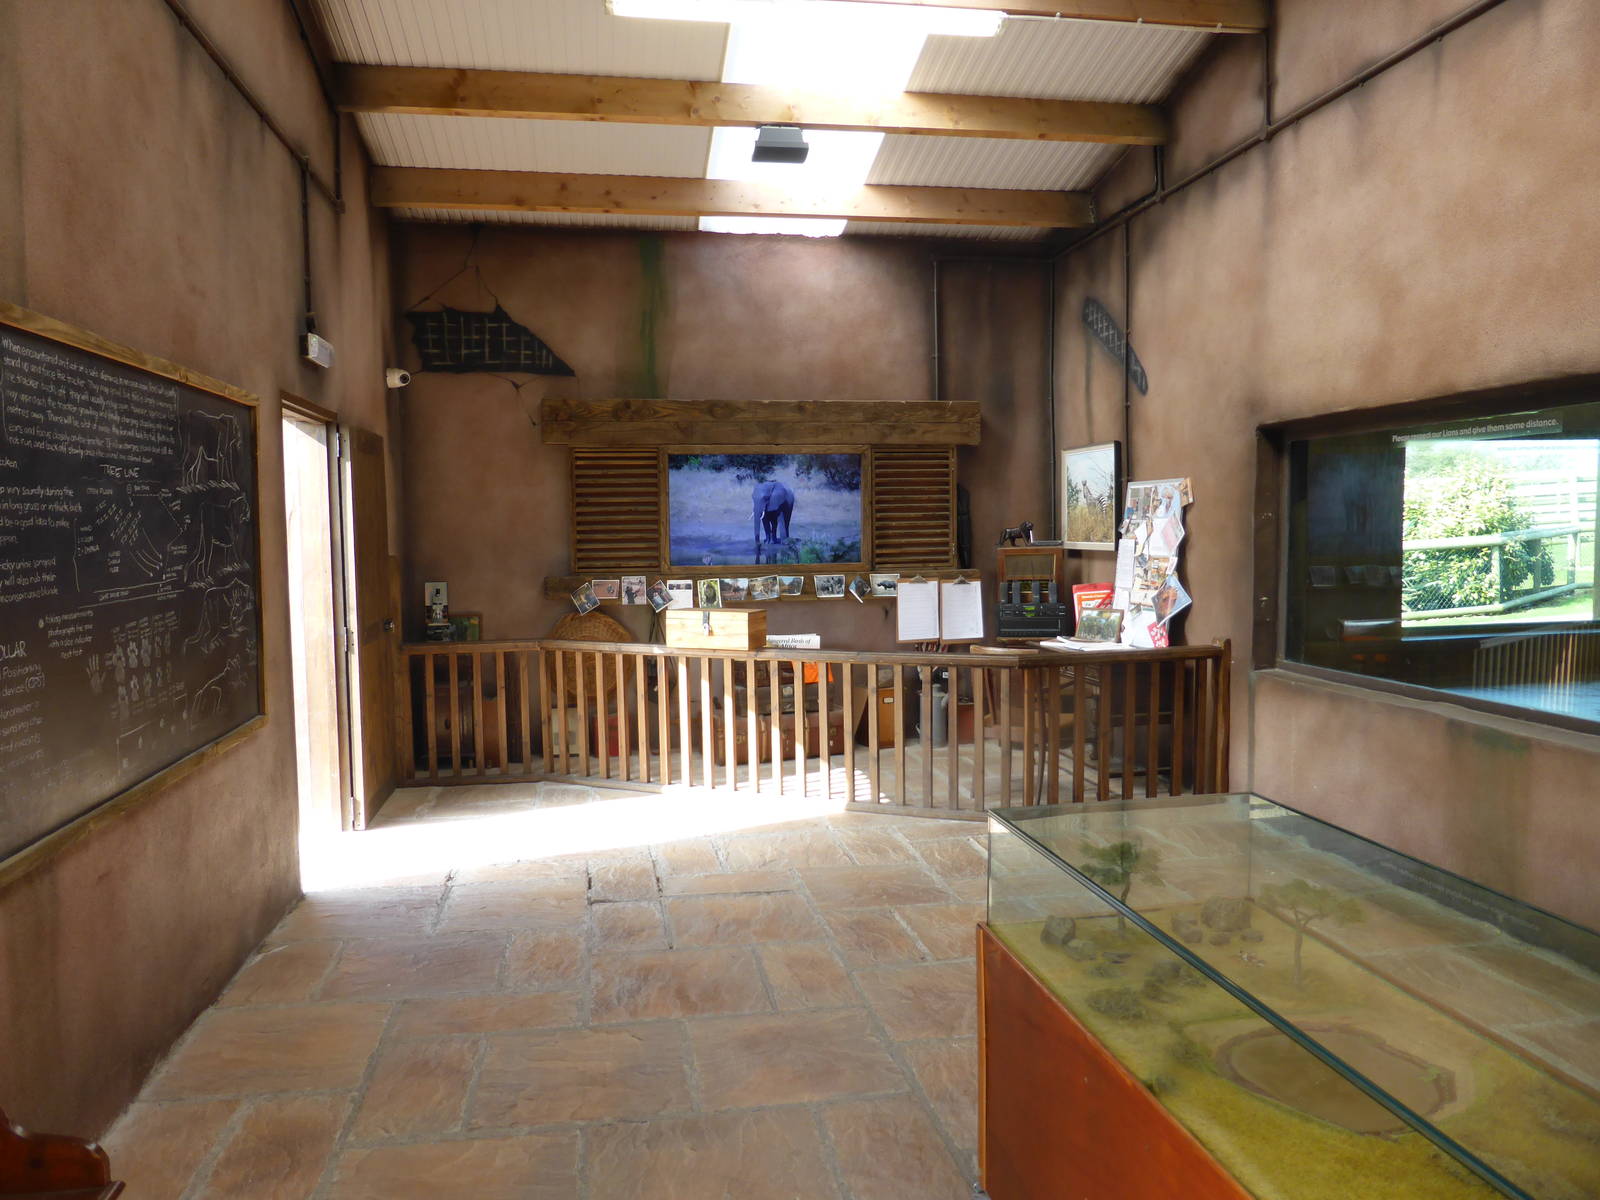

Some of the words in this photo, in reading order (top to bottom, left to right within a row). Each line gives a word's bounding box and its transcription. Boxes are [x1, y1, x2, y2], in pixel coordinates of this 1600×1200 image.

[1, 336, 20, 353] When
[1442, 429, 1458, 437] Lions
[1459, 427, 1471, 435] and
[1472, 426, 1486, 436] give
[1487, 423, 1505, 432] them
[1505, 422, 1525, 430] some
[1526, 418, 1559, 429] distance.
[6, 486, 19, 495] very
[22, 484, 43, 498] soundly
[8, 497, 22, 514] long
[23, 502, 39, 513] grass
[4, 574, 14, 586] will
